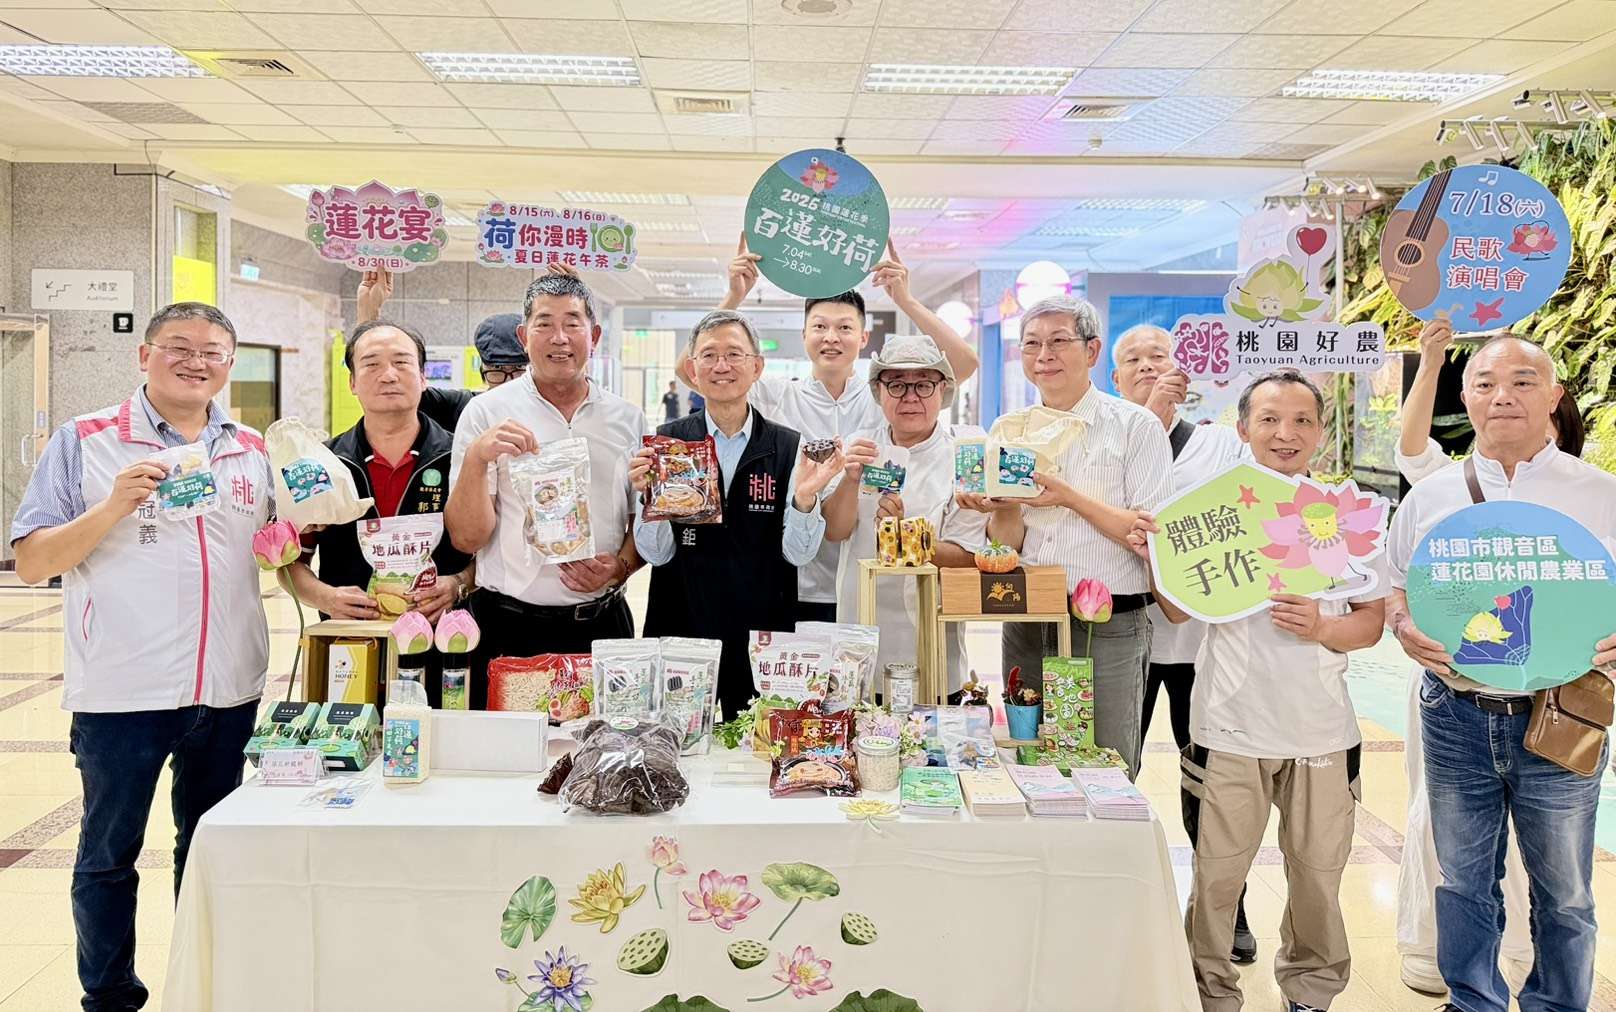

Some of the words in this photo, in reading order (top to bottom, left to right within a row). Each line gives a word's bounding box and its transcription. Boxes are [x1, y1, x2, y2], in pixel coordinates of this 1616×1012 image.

[780, 188, 820, 210] 2026
[1450, 190, 1545, 217] 7/18(六)
[324, 203, 433, 242] 蓮花宴
[484, 217, 588, 250] 荷你漫時
[754, 207, 880, 273] 百蓮好荷
[1451, 236, 1503, 260] 民歌
[514, 249, 609, 269] 夏日蓮花午茶
[782, 244, 805, 260] 7.04
[790, 259, 812, 275] 8.30
[1447, 265, 1528, 290] 演唱會
[1235, 330, 1379, 353] 桃園好農
[1236, 355, 1294, 366] Taoyuan
[1300, 354, 1380, 366] Agriculture
[138, 500, 158, 545] 冠義
[1165, 504, 1248, 556] 體驗
[371, 541, 432, 557] 地瓜酥片
[1428, 536, 1559, 558] 桃園市觀音區
[1183, 549, 1262, 596] 手作
[1431, 559, 1609, 582] 蓮花園休閒農業區
[758, 661, 819, 677] 地瓜酥片
